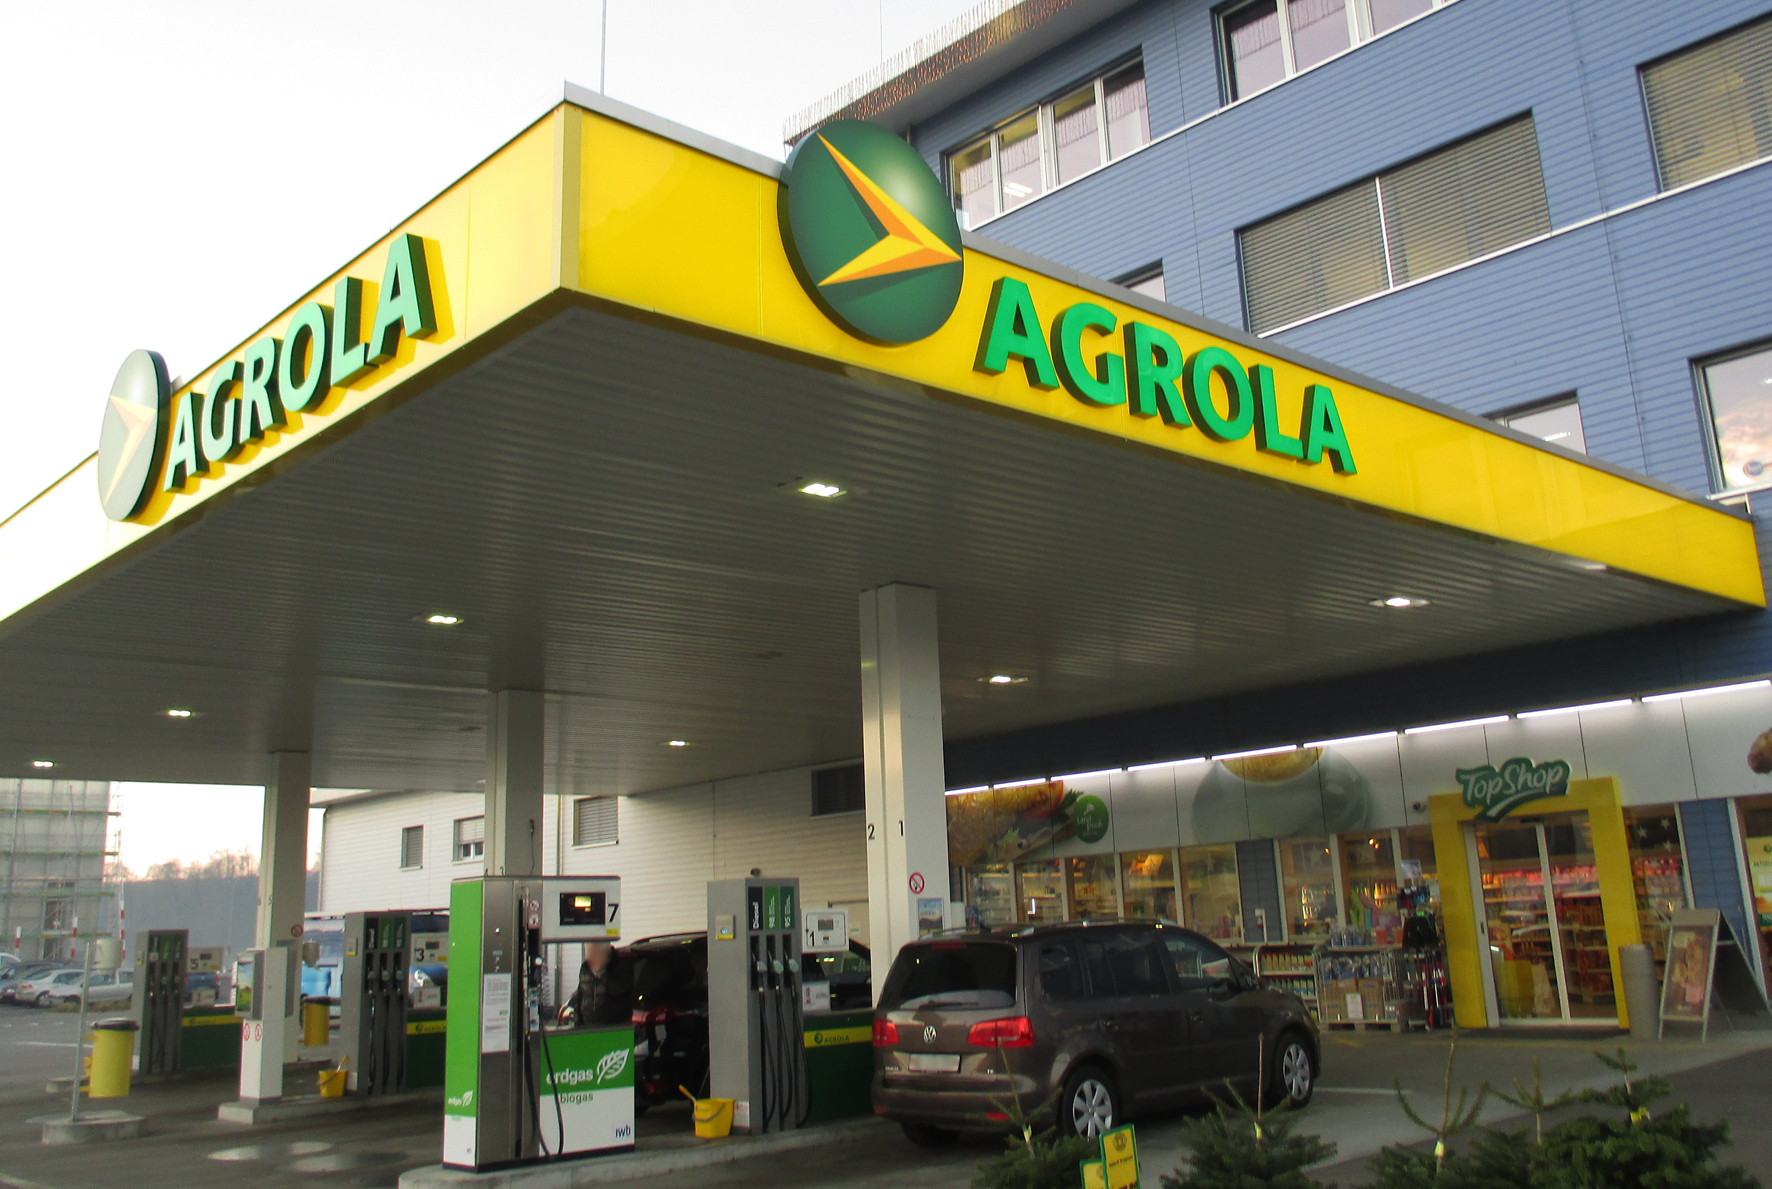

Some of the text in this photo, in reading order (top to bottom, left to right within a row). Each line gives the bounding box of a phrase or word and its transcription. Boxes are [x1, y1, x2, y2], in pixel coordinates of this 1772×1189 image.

[164, 233, 437, 492] AGROLA
[973, 277, 1357, 476] AGROLA
[1460, 763, 1563, 805] TopShop
[867, 824, 875, 840] 2
[898, 820, 904, 837] 1
[608, 903, 619, 923] 7
[752, 901, 760, 930] Diesel
[784, 915, 792, 928] 95
[809, 930, 815, 947] 1
[415, 947, 425, 962] 3
[190, 958, 199, 970] 5
[546, 1068, 594, 1085] erdgas
[560, 1092, 594, 1104] biogas
